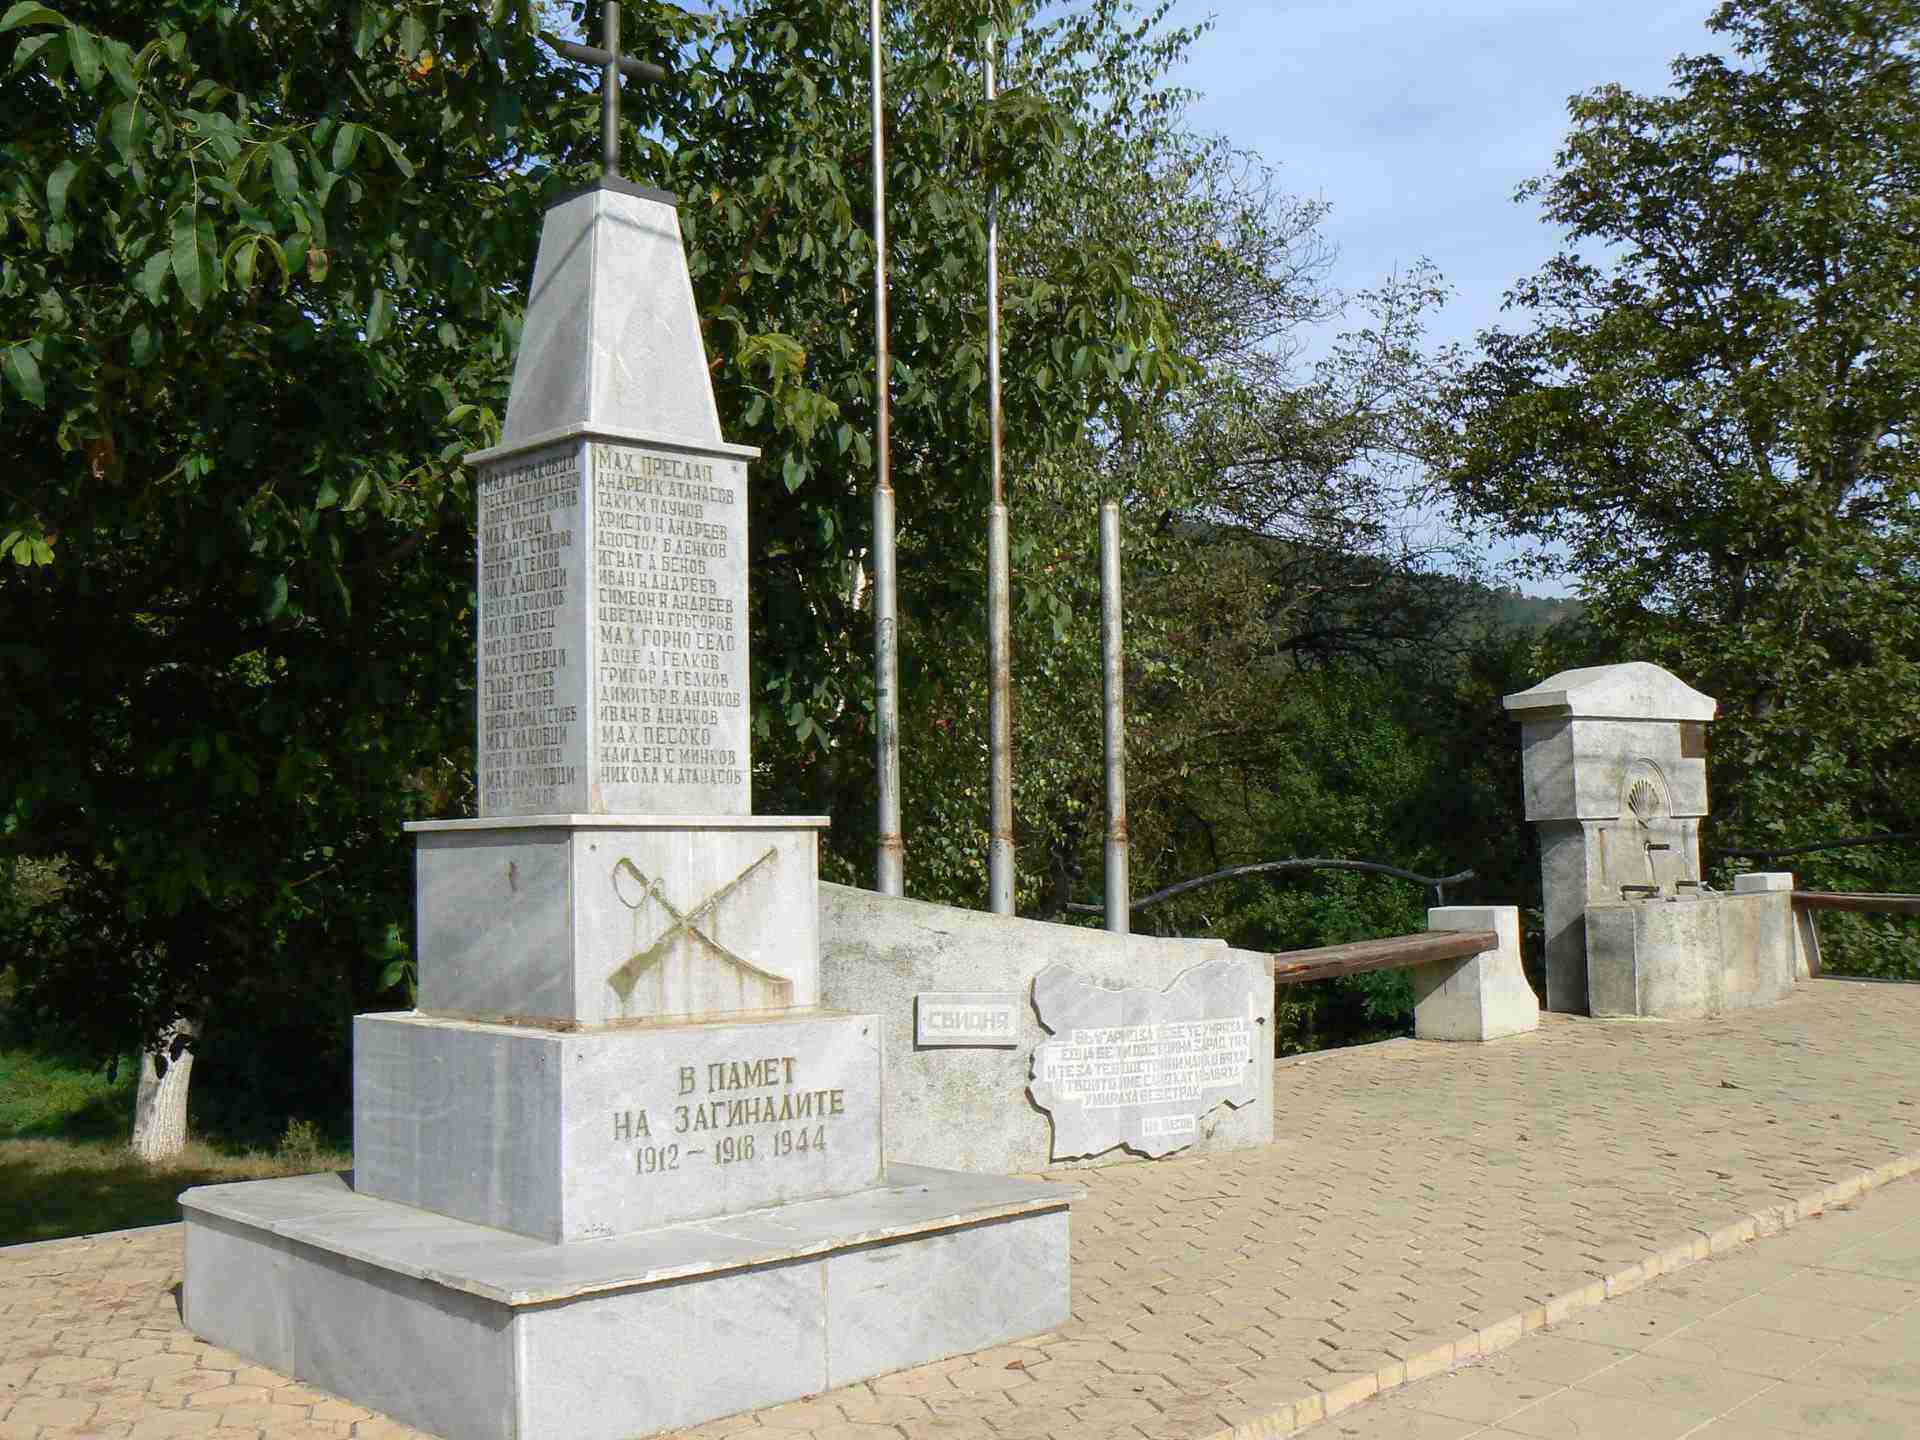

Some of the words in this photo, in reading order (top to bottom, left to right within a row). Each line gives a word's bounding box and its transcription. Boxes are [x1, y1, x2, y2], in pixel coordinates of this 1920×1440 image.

[598, 450, 633, 472] МАХ
[668, 480, 735, 504] АТАНАСОВ
[597, 510, 650, 532] ХРИСТО
[667, 518, 727, 540] АНДРЕЕВ
[597, 549, 643, 568] ИГНАТ
[598, 569, 634, 587] ИВАН
[652, 573, 716, 594] АНДРЕЕВ
[598, 588, 655, 607] СИМЕОН
[672, 594, 733, 614] АНДРЕЕВ
[598, 606, 652, 624] ЦВЕТАН
[484, 618, 506, 638] МАХ
[600, 625, 634, 644] МАХ
[641, 628, 691, 648] ГОРНО
[696, 632, 735, 651] СЕЛО
[485, 656, 506, 676] МАХ
[647, 650, 656, 665] А
[661, 651, 719, 669] ГЕЛКОВ
[599, 665, 656, 684] ГРИГОР
[662, 669, 669, 685] А
[674, 670, 729, 688] ГЕЛКОВ
[599, 685, 666, 704] ДИМИТЪР
[683, 690, 740, 708] АНАЧКОВ
[600, 705, 637, 722] ИВАН
[642, 707, 650, 722] В
[657, 708, 718, 725] АНАЧКОВ
[601, 724, 639, 743] МАХ
[644, 726, 711, 746] ПЕСОКО
[665, 747, 674, 763] С
[599, 765, 658, 783] НИКОЛА
[677, 767, 741, 785] АТАНАСОВ
[677, 1066, 697, 1097] В
[707, 1056, 797, 1094] ПАМЕТ
[612, 1109, 652, 1141] НА
[674, 1089, 845, 1134] ЗАГИНАЛИТЕ
[634, 1143, 681, 1175] 1912
[774, 1124, 827, 1157] 1944
